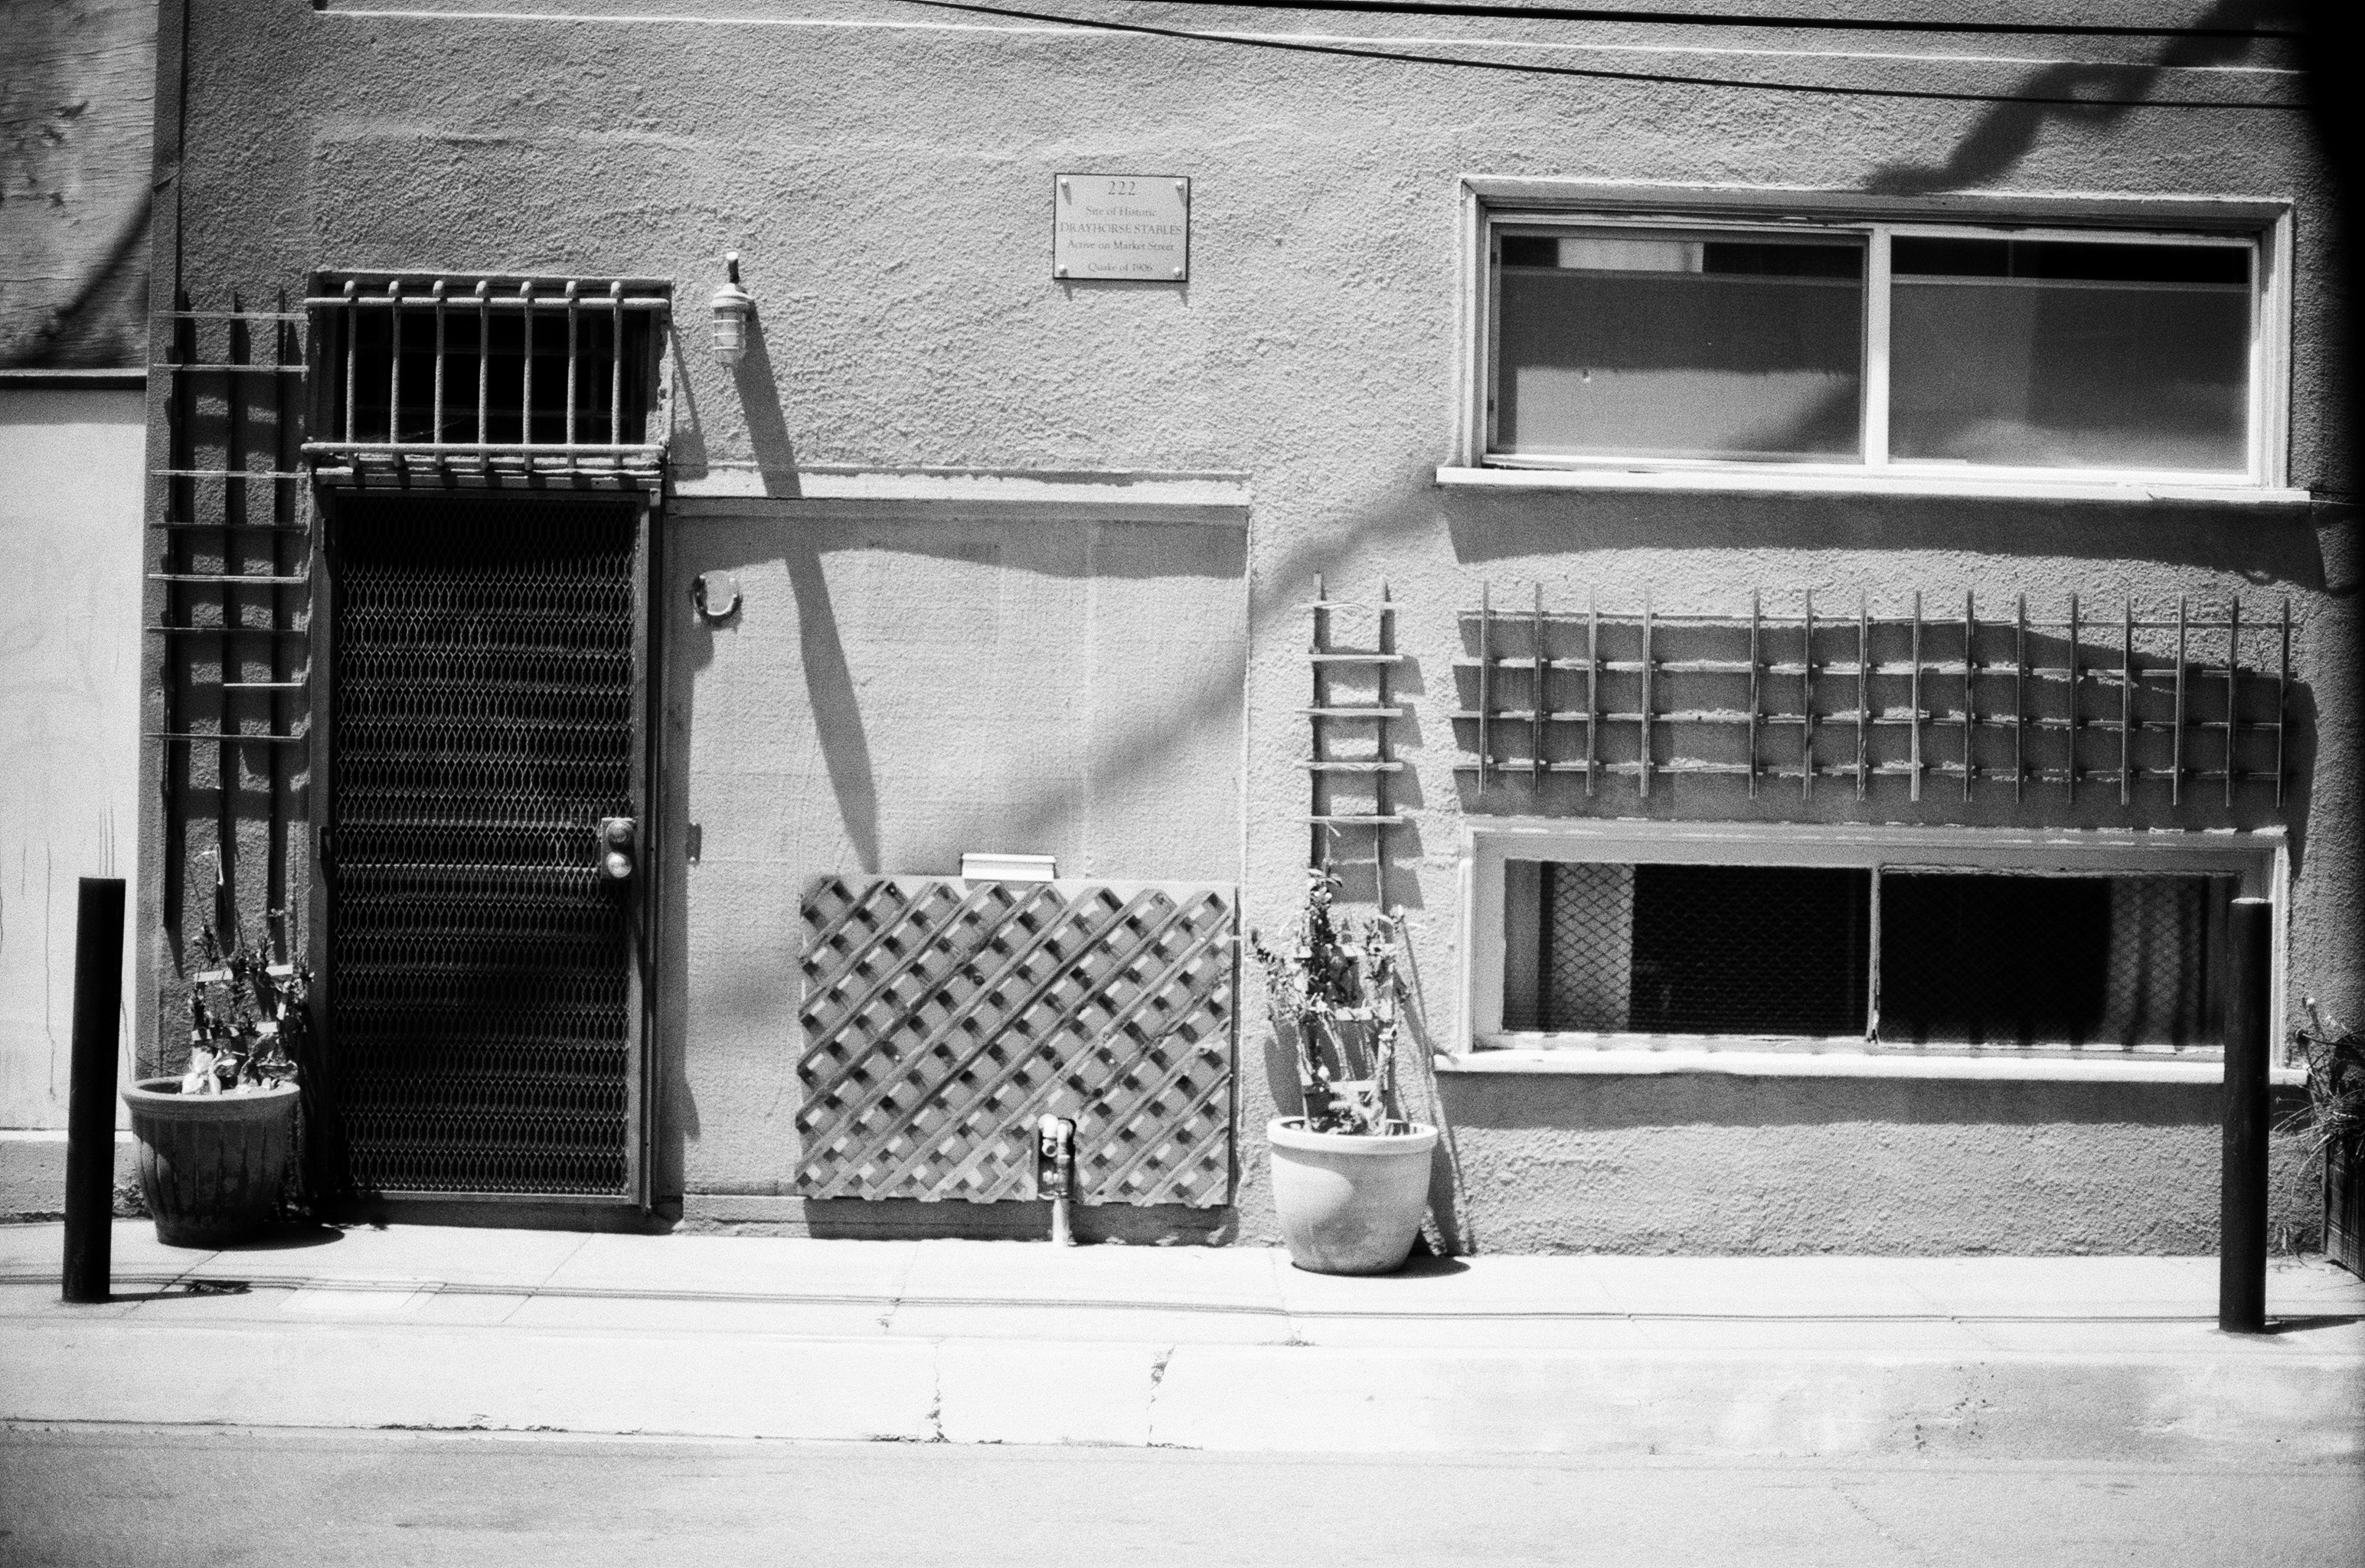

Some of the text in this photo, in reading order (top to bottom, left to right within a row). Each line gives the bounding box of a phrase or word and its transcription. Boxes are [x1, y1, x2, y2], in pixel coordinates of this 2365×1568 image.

[1108, 181, 1135, 195] 222
[1086, 206, 1157, 217] Site of Historic
[1060, 222, 1182, 235] DRAYHORSE STABLES
[1067, 240, 1096, 249] Active
[1113, 240, 1145, 250] Market
[1148, 241, 1174, 251] Street
[1088, 262, 1116, 273] Quake
[1132, 263, 1153, 272] 1906
